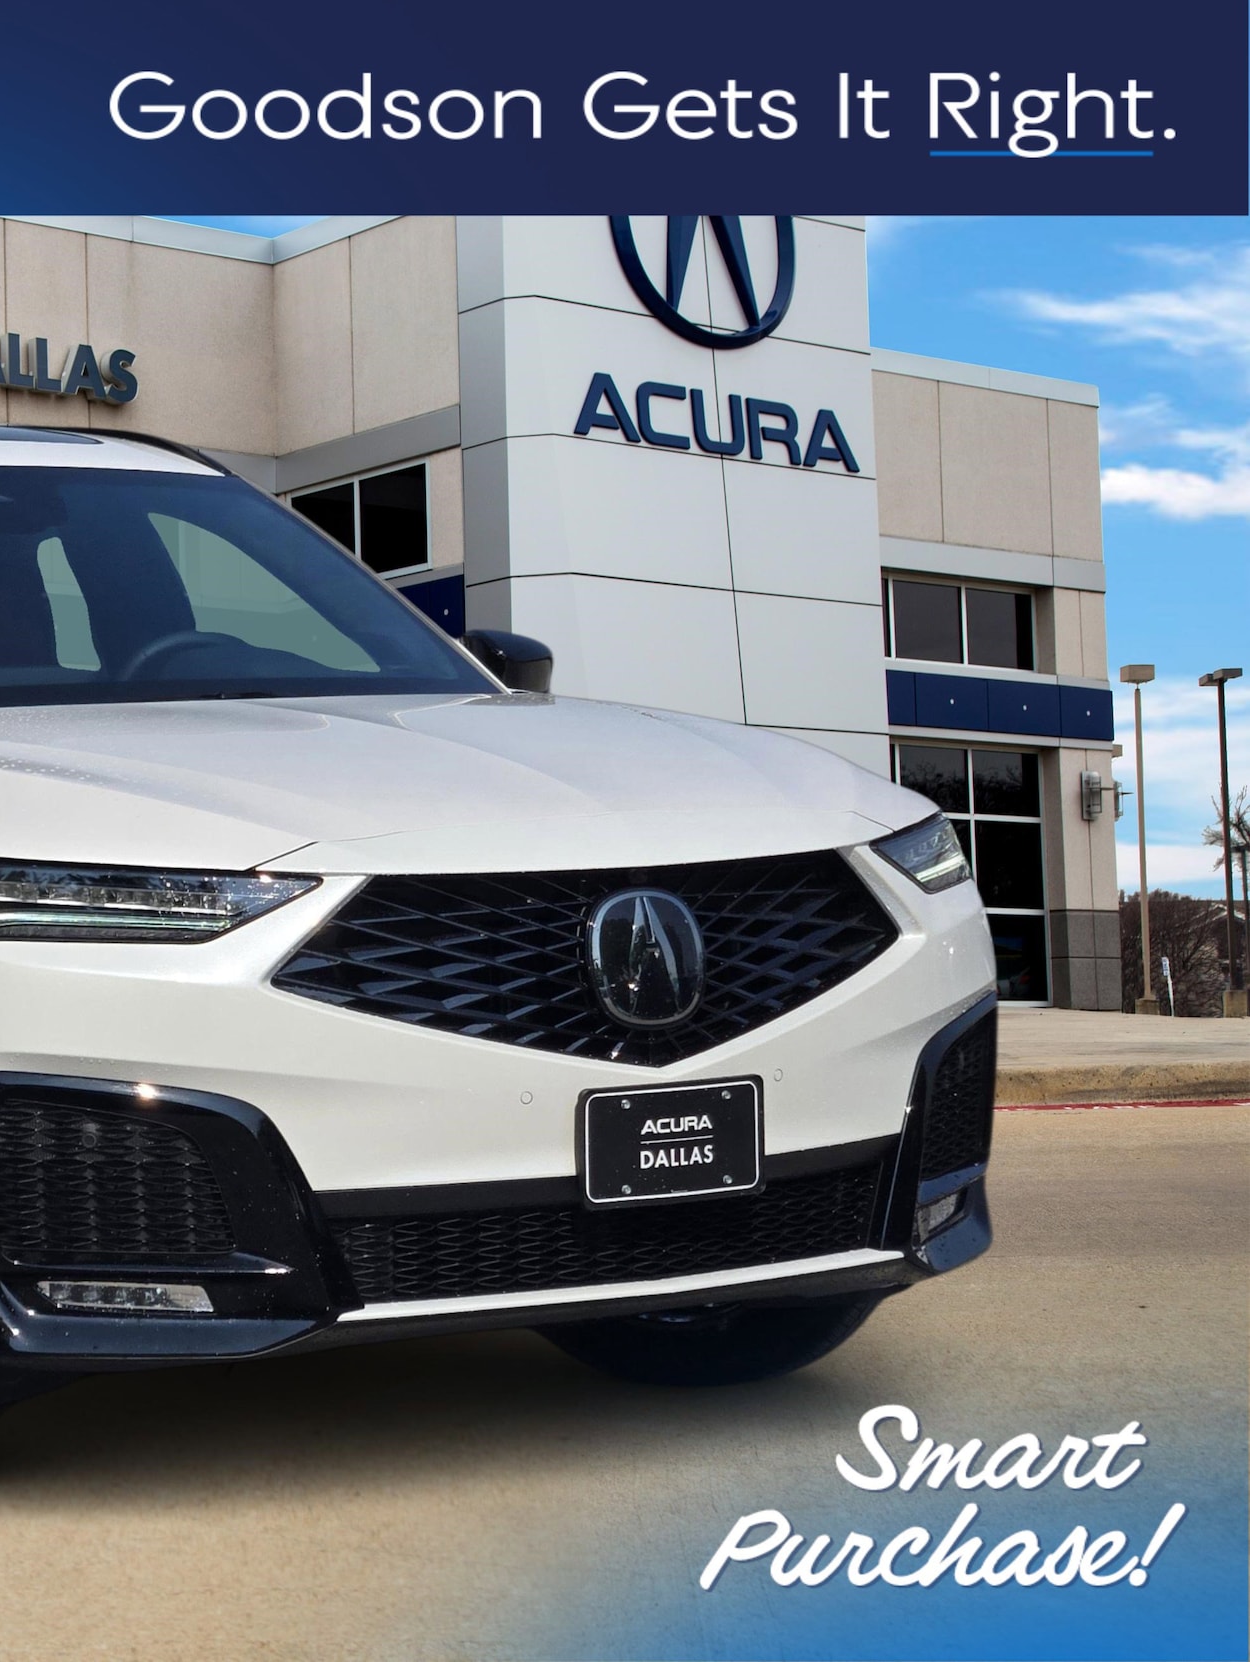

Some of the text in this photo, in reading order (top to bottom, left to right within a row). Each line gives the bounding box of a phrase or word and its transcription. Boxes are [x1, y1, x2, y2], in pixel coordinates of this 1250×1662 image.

[573, 372, 860, 473] ACURA
[640, 1114, 713, 1135] ACURA
[640, 1144, 714, 1170] DALLAS
